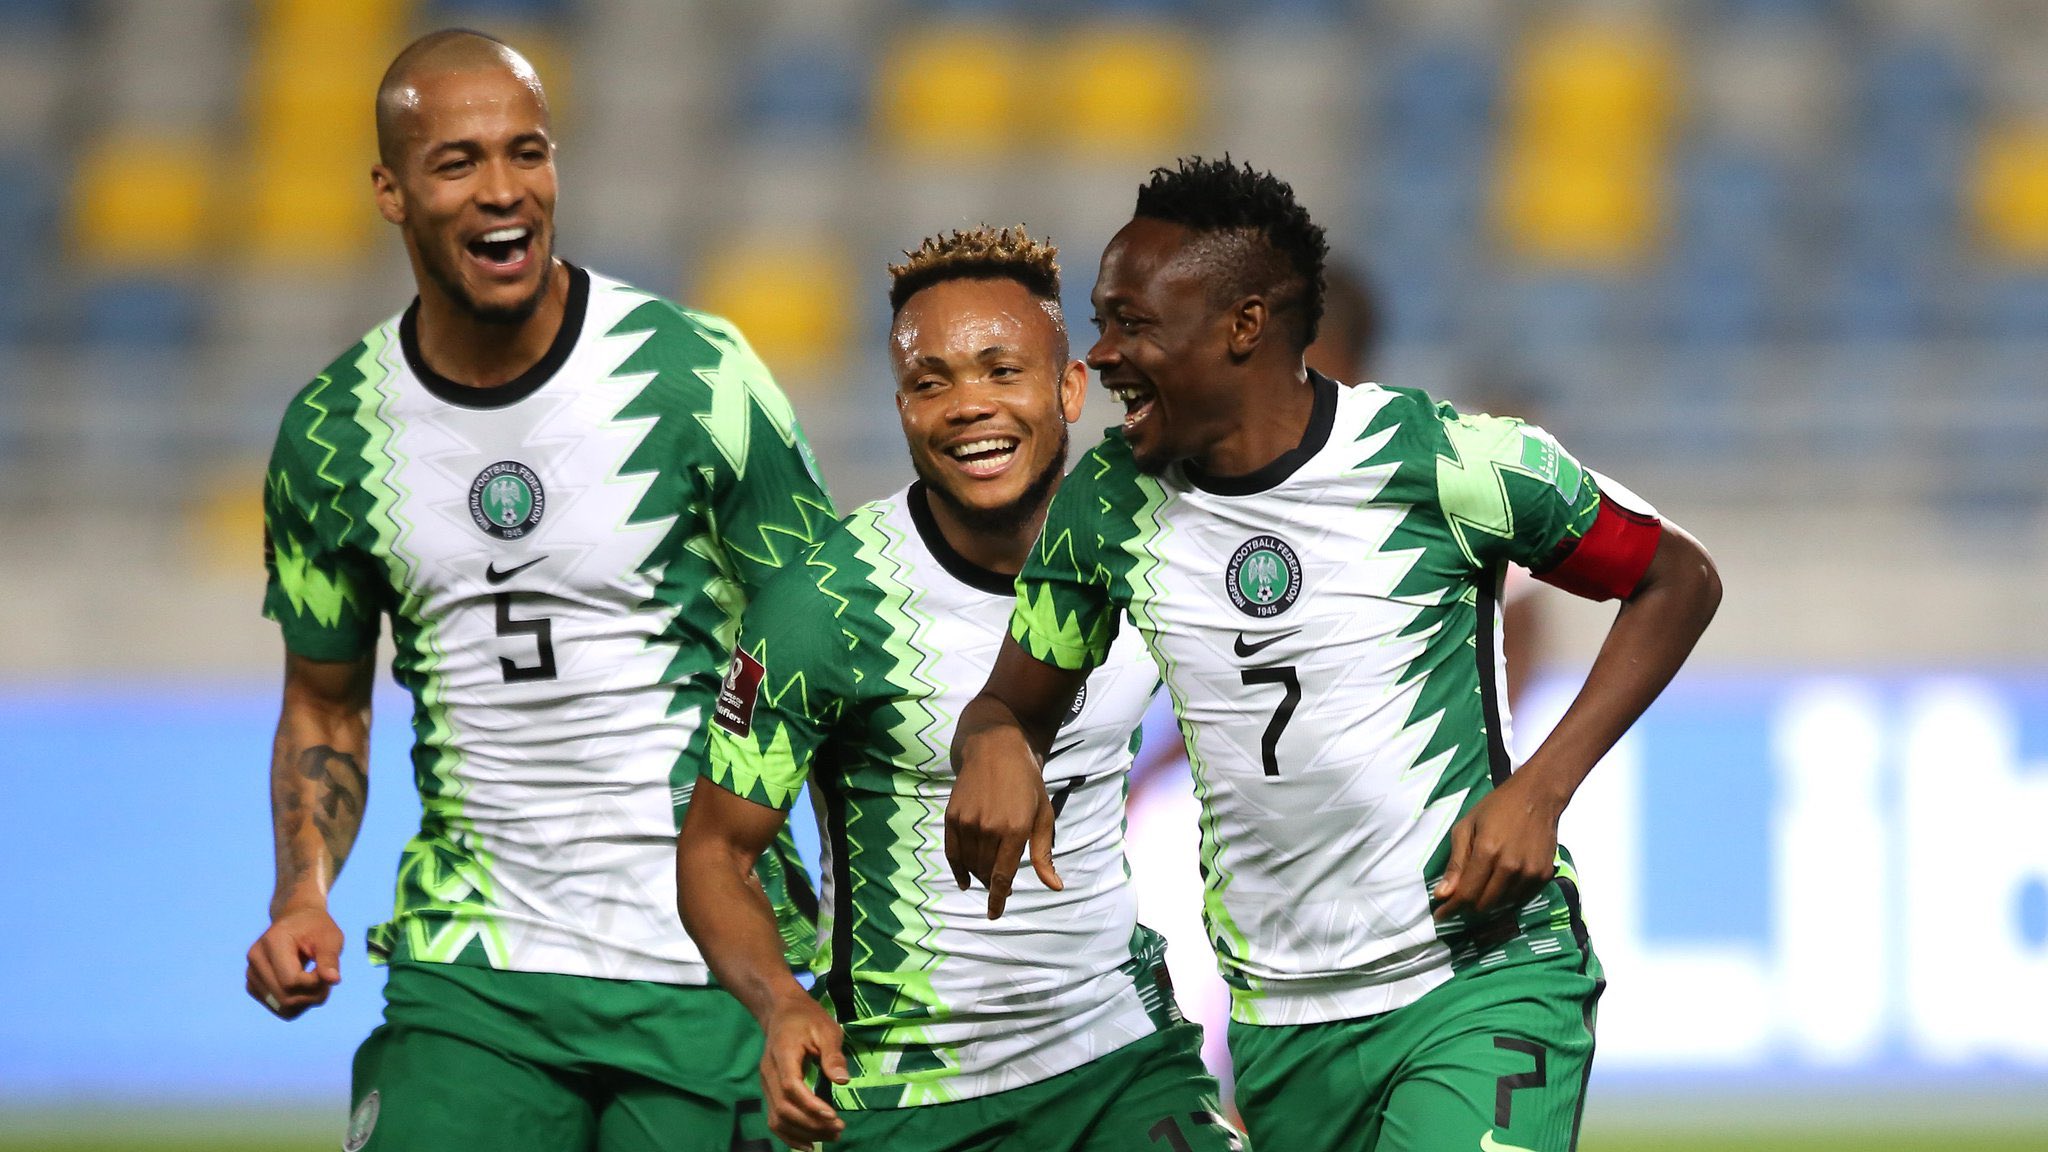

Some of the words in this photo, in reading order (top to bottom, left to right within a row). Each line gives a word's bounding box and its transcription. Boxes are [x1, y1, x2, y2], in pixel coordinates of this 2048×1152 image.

[474, 463, 517, 492] FOOTBALL
[518, 467, 543, 525] FEDERATION
[471, 493, 491, 531] NIGERIA
[502, 528, 523, 538] 1945
[1232, 538, 1275, 567] FOOTBALL
[1228, 568, 1246, 608] NIGERIA
[1276, 544, 1300, 603] FEDERATION
[1257, 605, 1277, 616] 1945
[494, 590, 557, 684] 5
[1071, 686, 1085, 714] TION
[1240, 666, 1302, 776] 7
[1493, 1036, 1547, 1130] 7
